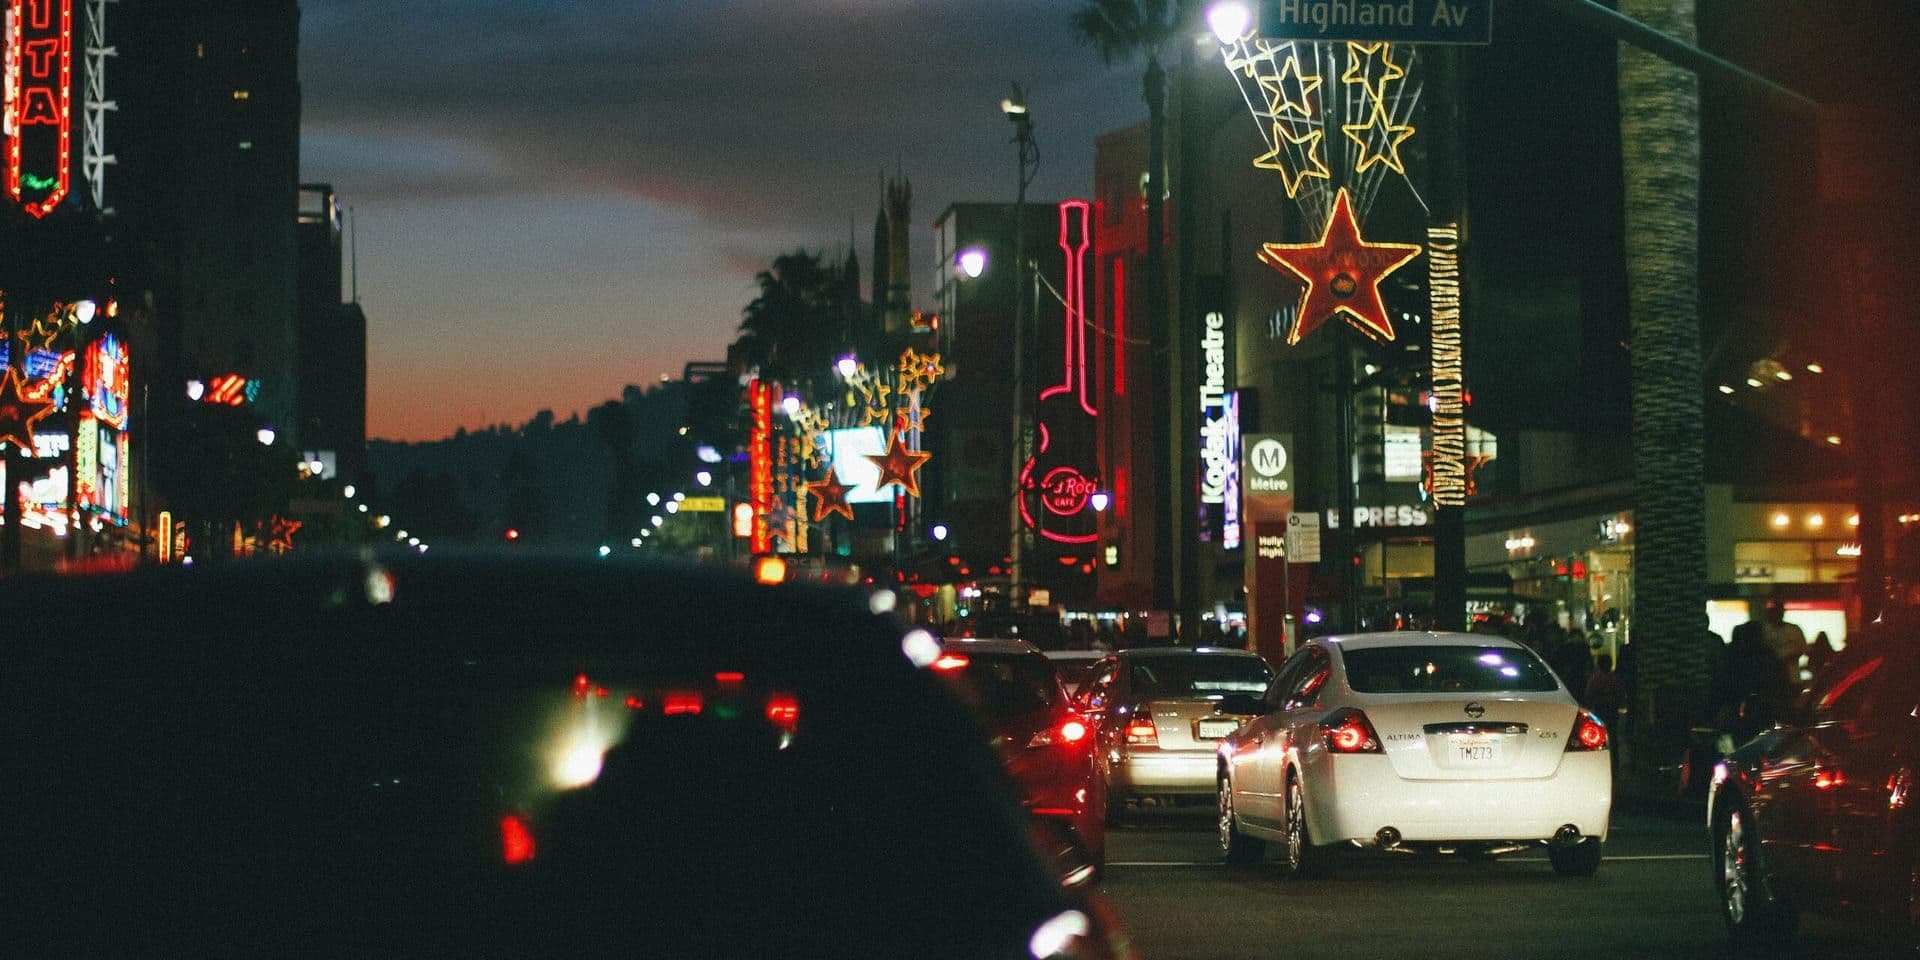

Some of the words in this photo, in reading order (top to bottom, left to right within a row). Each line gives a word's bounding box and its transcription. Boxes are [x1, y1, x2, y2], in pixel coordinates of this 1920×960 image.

[1280, 0, 1414, 33] Highland
[1431, 0, 1468, 27] Av
[1200, 312, 1224, 413] Theatre
[1251, 478, 1288, 491] Metro
[1459, 746, 1493, 760] TMZ73
